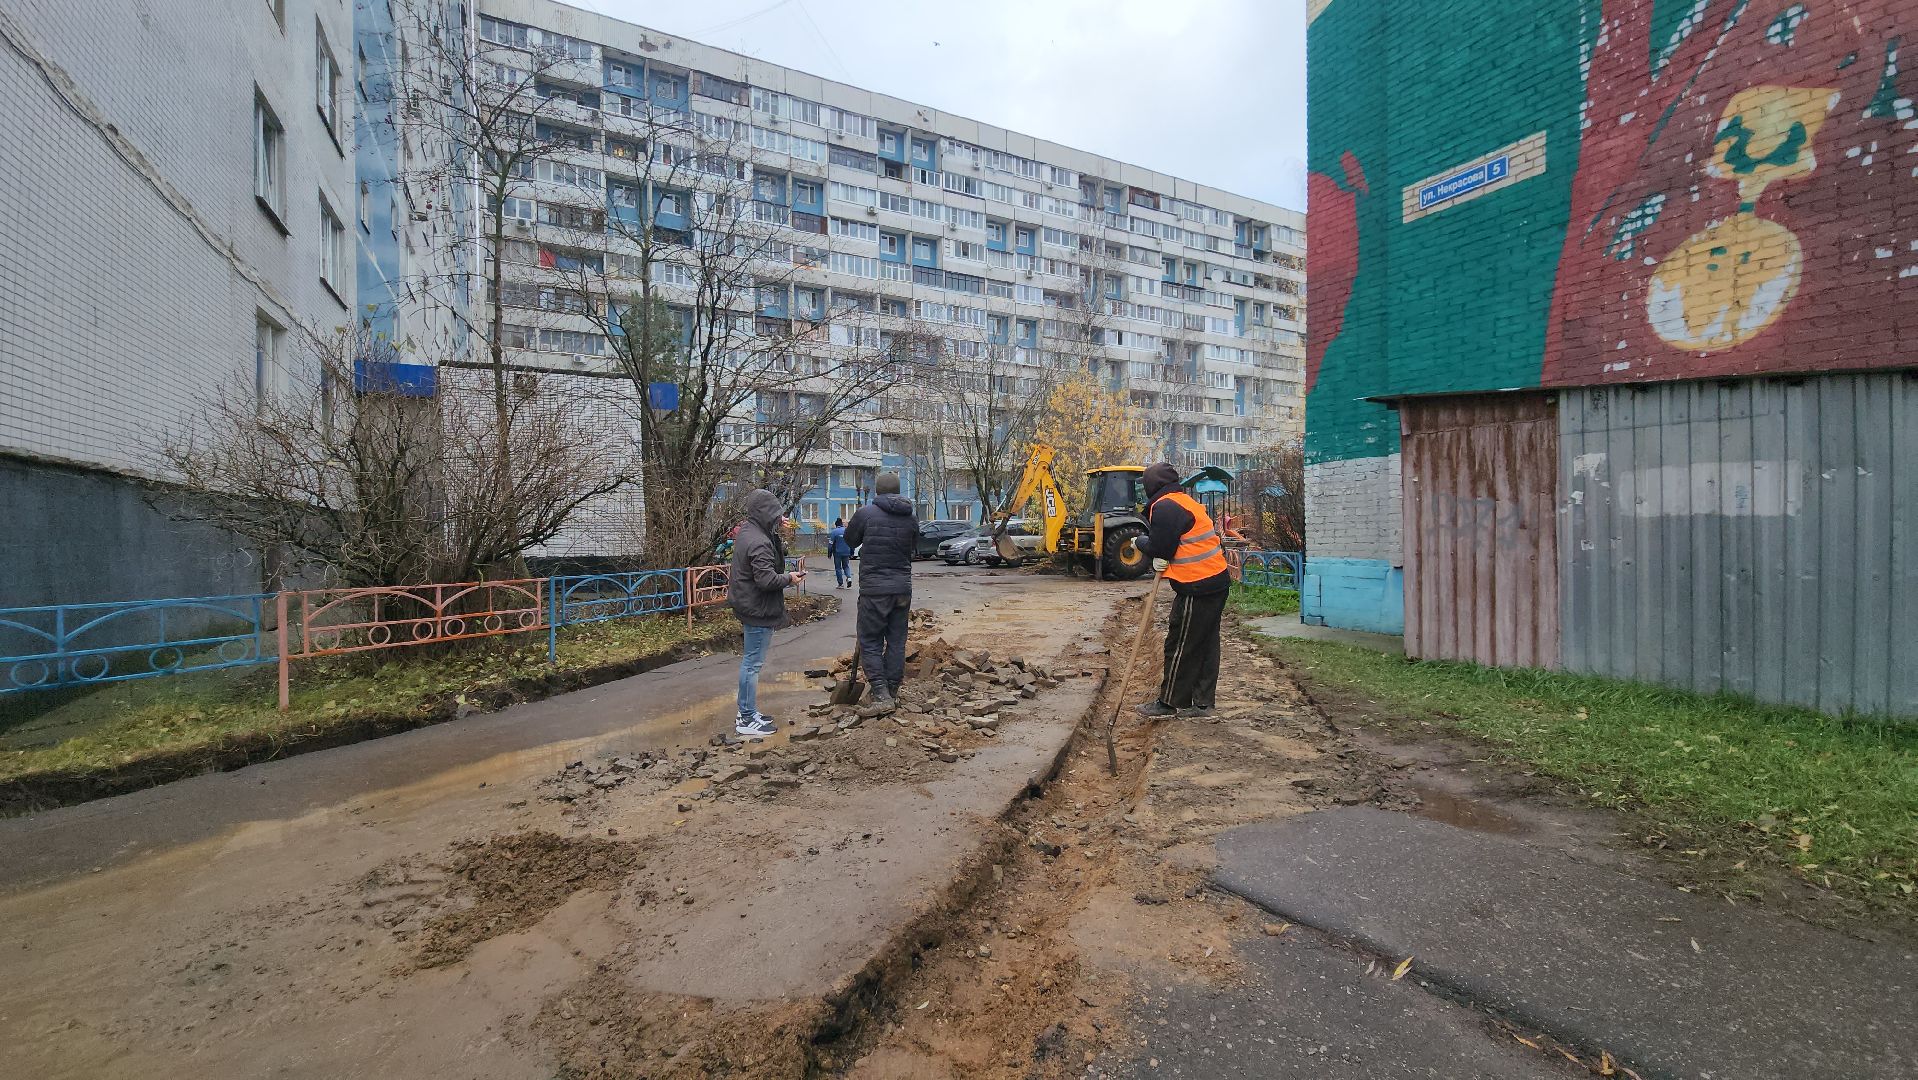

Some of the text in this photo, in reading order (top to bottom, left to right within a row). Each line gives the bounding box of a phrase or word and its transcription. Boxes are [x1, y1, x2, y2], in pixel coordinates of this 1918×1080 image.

[1422, 163, 1501, 204] ул. Некрасова 5
